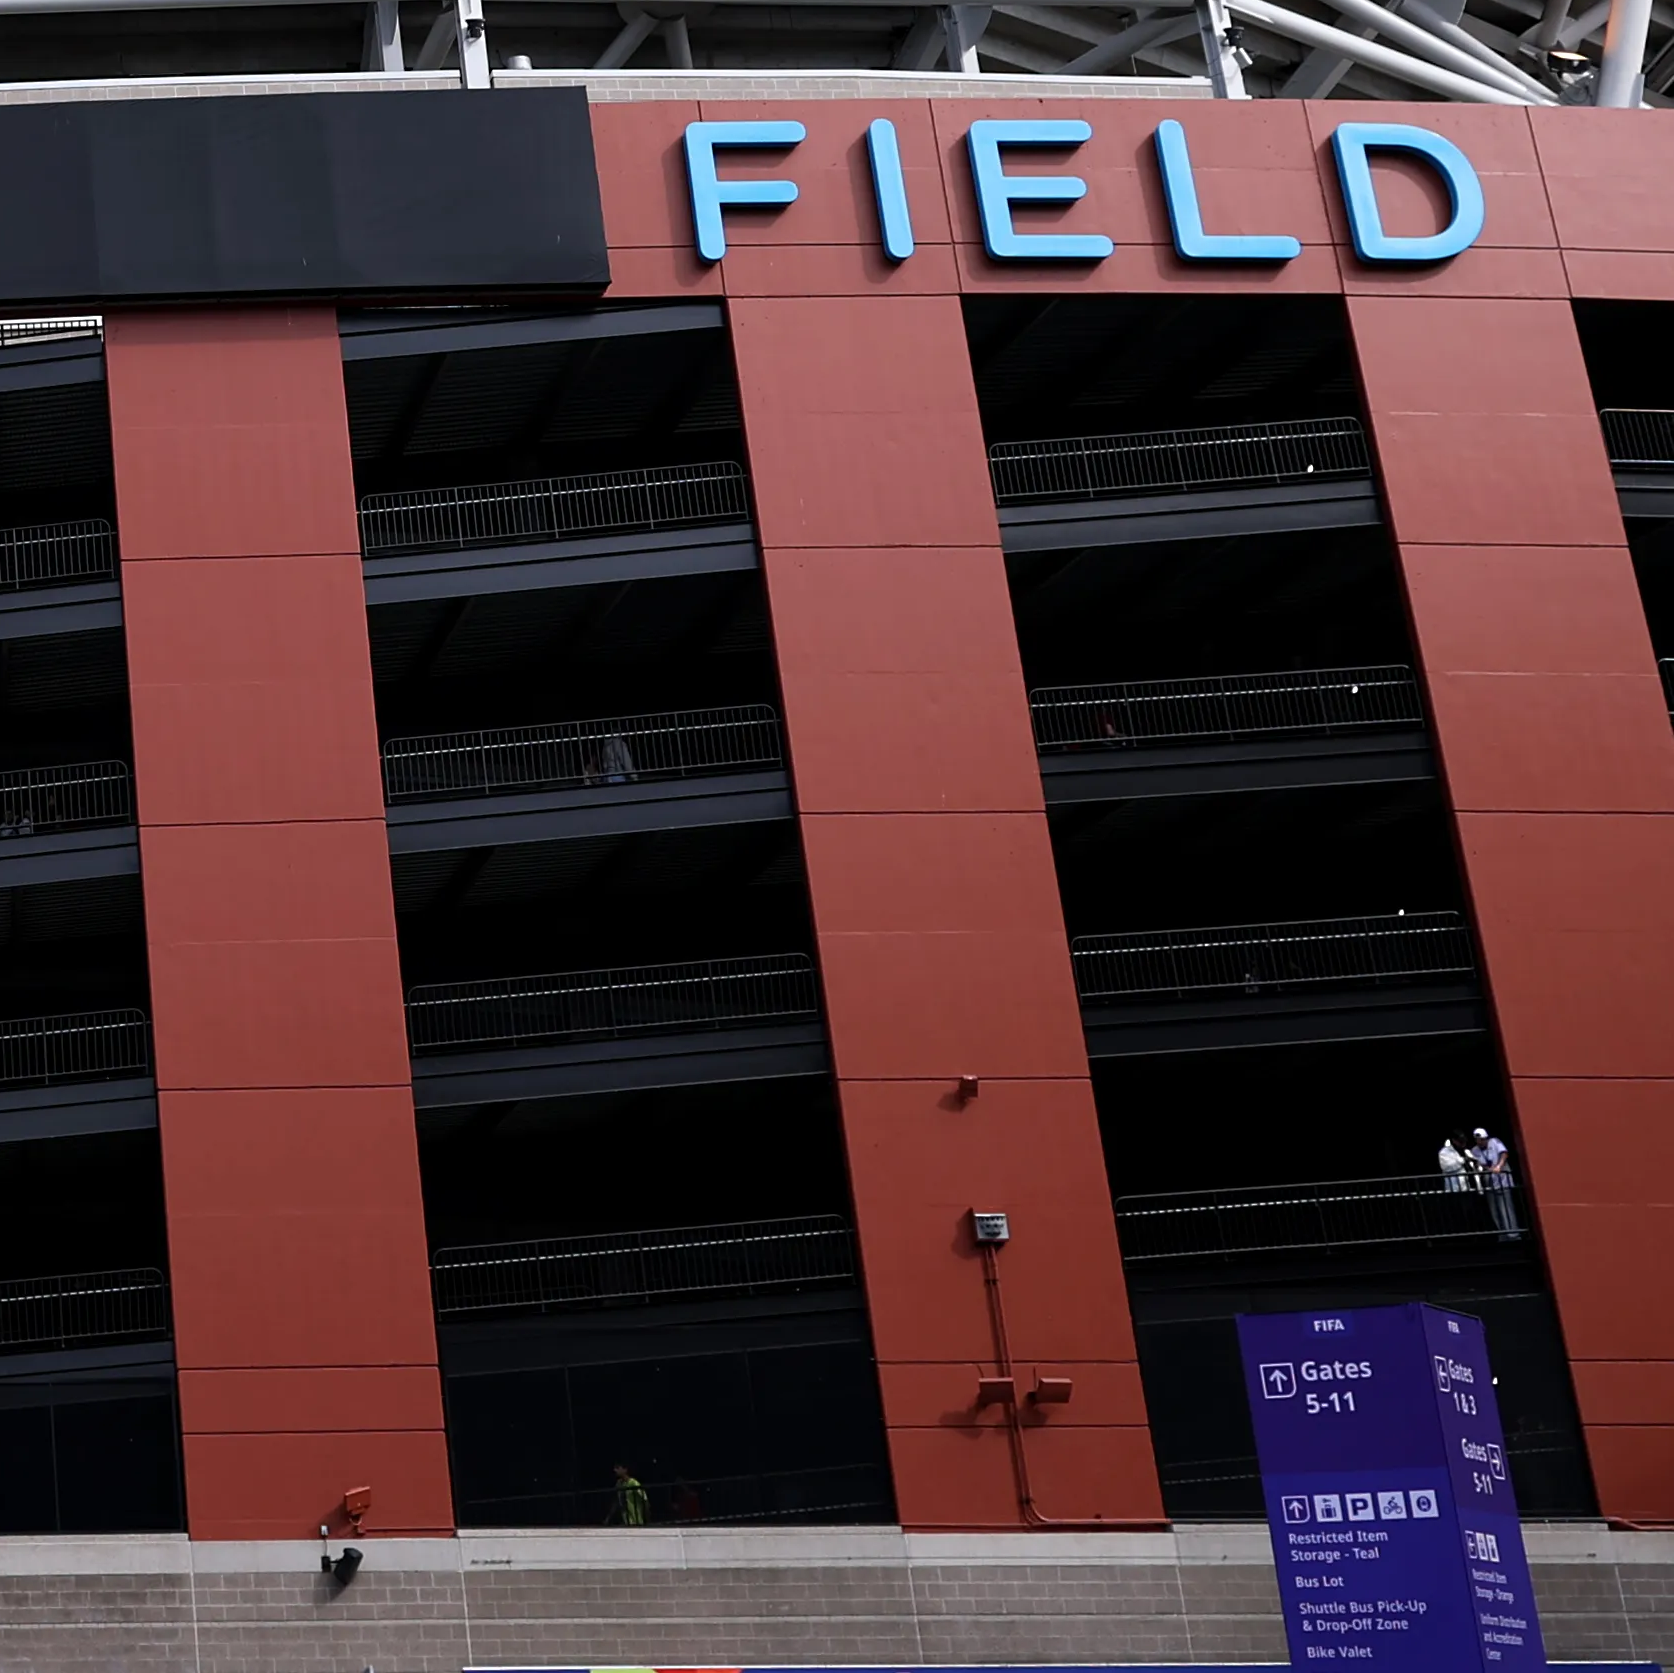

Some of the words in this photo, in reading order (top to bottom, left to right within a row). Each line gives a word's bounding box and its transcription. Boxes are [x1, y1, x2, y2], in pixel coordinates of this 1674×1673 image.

[683, 118, 1486, 266] FIELD
[1313, 1319, 1345, 1332] FIFA
[1301, 1360, 1372, 1381] Gates
[1448, 1359, 1474, 1384] Gates
[1306, 1391, 1355, 1414] 5-11
[1453, 1392, 1460, 1412] 1
[1469, 1395, 1477, 1415] 3
[1461, 1438, 1487, 1462] Gates
[1288, 1531, 1353, 1545] Restricted
[1357, 1531, 1389, 1542] Item
[1291, 1549, 1341, 1563] Storage
[1352, 1547, 1380, 1560] Teal
[1295, 1576, 1320, 1588] Bus
[1323, 1575, 1344, 1587] Lot
[1299, 1601, 1346, 1615] Shuttle
[1350, 1601, 1374, 1613] Bus
[1377, 1600, 1427, 1615] Pick-Up
[1303, 1620, 1313, 1632] &
[1316, 1618, 1372, 1634] Drop-Off
[1376, 1618, 1409, 1630] Zone
[1306, 1646, 1335, 1658] Bike
[1338, 1645, 1373, 1658] Valet
